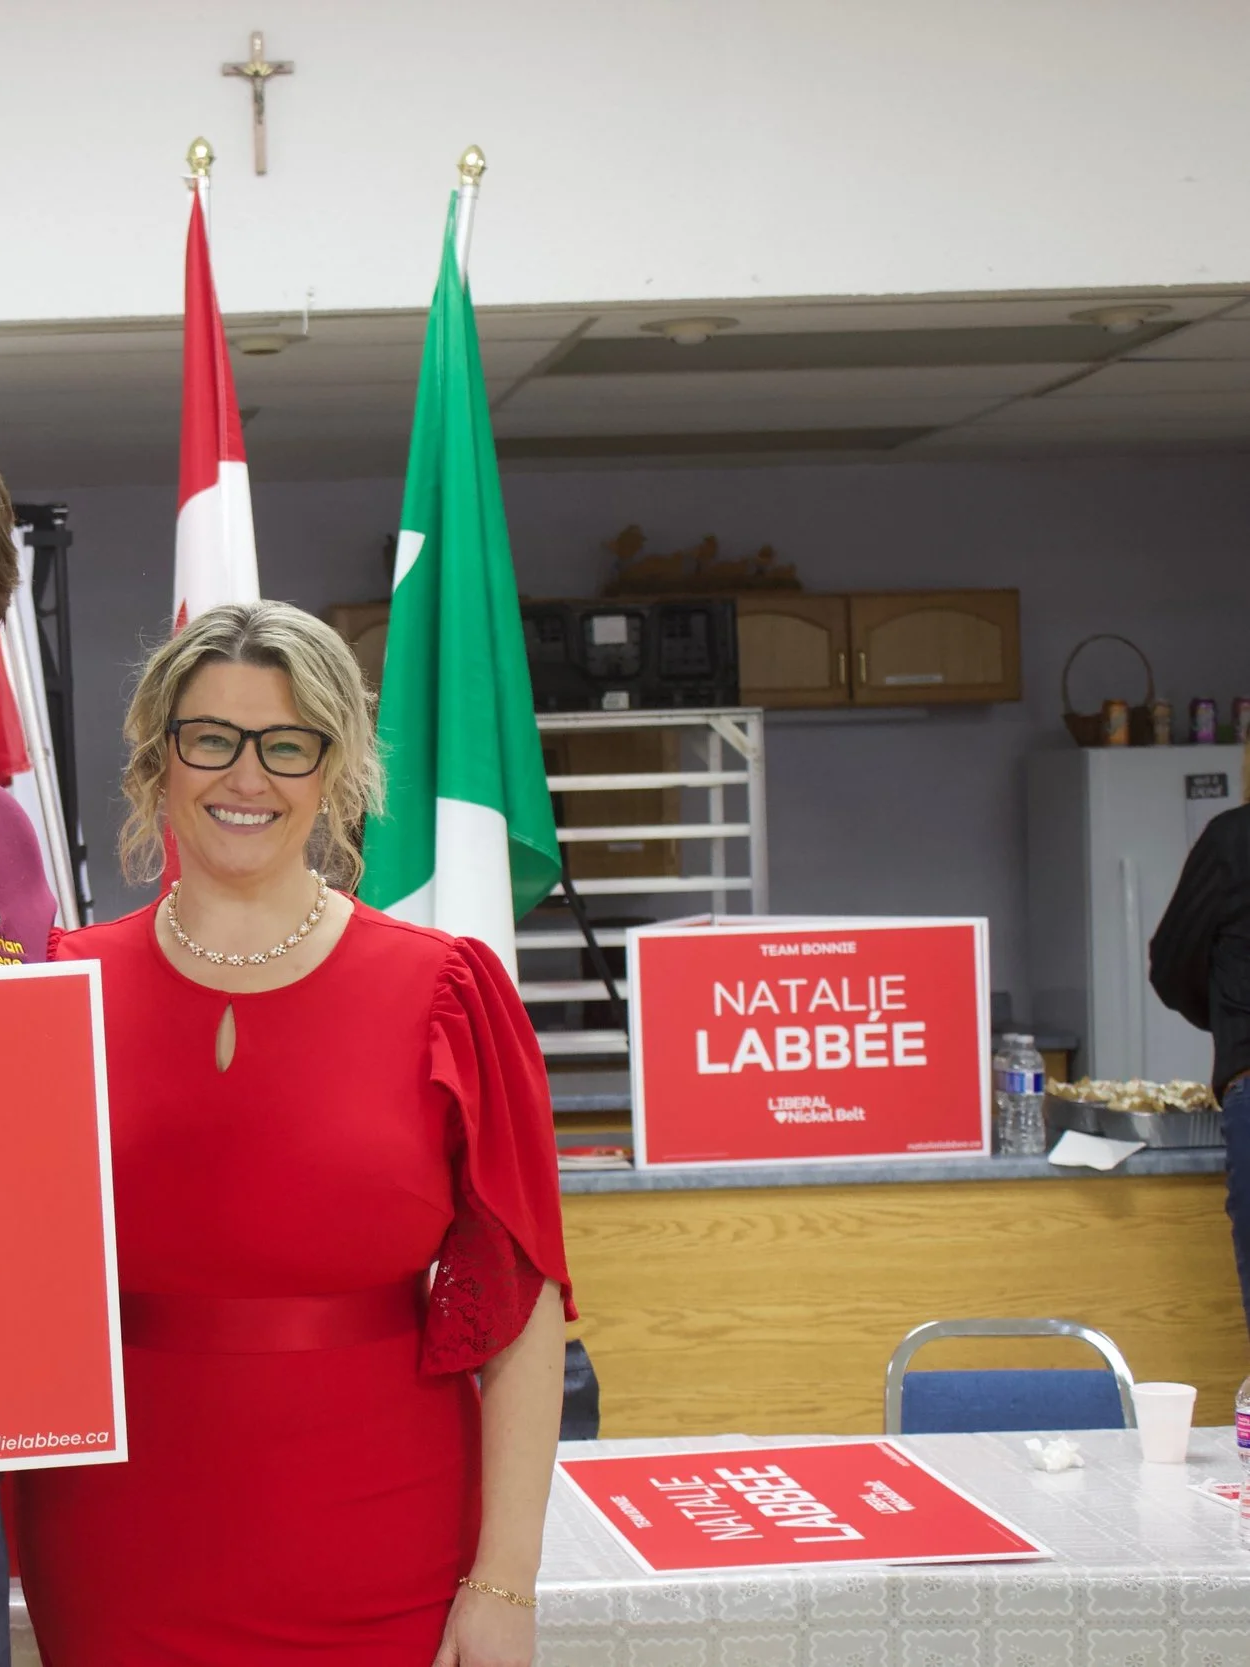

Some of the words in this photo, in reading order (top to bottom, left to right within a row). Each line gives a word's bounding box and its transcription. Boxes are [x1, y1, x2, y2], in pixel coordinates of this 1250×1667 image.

[760, 944, 799, 958] TEAM
[802, 940, 857, 956] BONNIE
[713, 974, 907, 1016] NATALIE
[696, 1012, 928, 1075] LABBÉE
[768, 1095, 831, 1112] LIBERAL
[648, 1475, 765, 1542] NATALIE
[707, 1464, 866, 1543] LABBÉE
